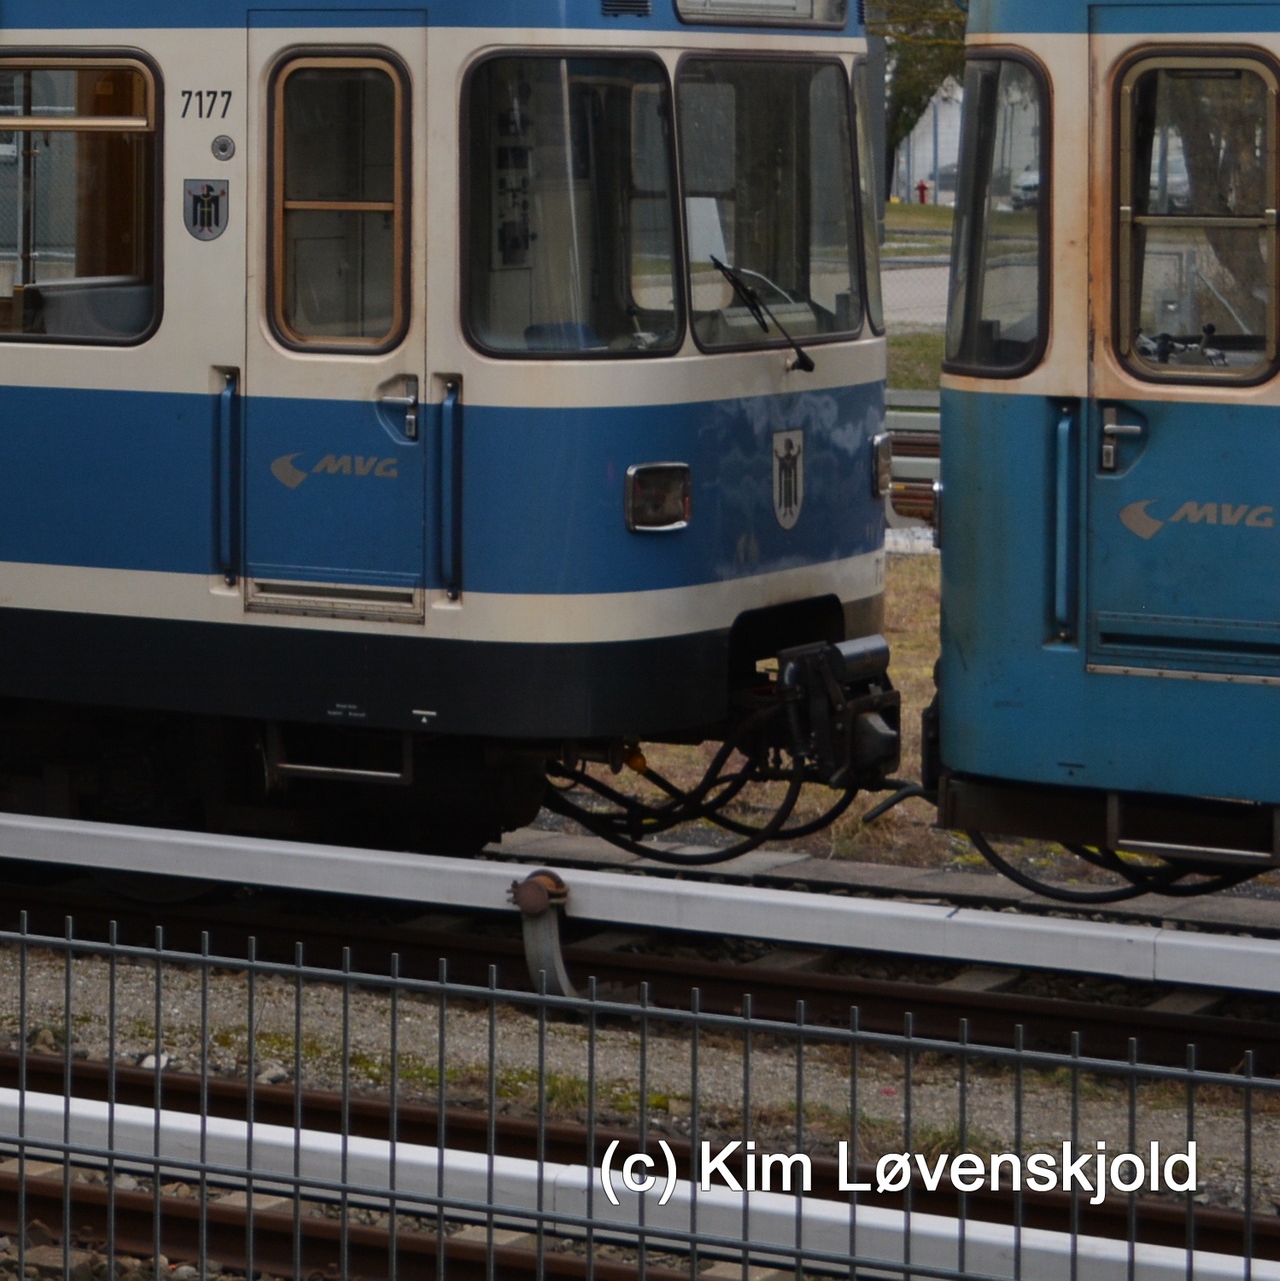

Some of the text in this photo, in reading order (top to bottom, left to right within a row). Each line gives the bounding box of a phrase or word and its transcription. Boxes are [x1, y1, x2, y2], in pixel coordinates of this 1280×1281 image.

[181, 90, 232, 119] 7177
[312, 454, 398, 478] MVG
[1169, 501, 1275, 527] MVG
